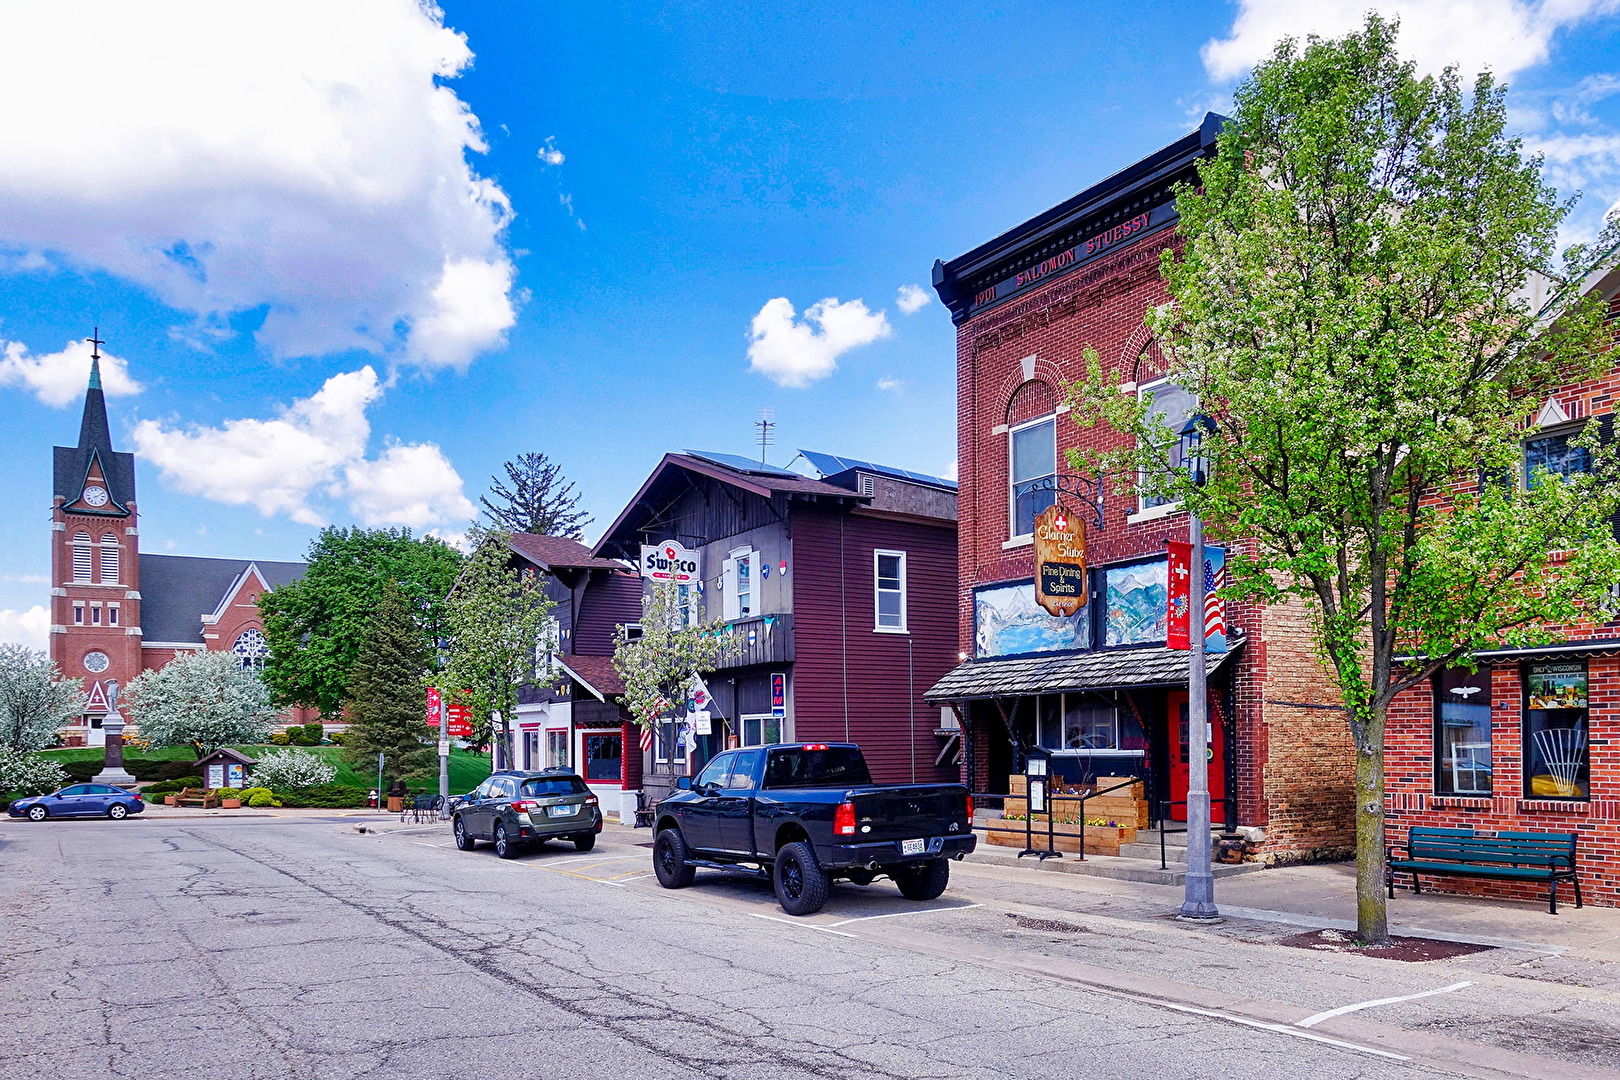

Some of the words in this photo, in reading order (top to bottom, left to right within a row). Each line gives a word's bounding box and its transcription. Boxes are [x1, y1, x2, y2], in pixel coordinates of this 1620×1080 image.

[974, 286, 997, 307] 1901
[1016, 248, 1076, 287] SALOMON
[1087, 212, 1151, 253] STUESSY
[1038, 525, 1074, 542] Glarner
[1057, 543, 1084, 558] Stube
[1042, 566, 1059, 576] Fine
[1059, 566, 1081, 580] Dining
[1060, 576, 1065, 584] &
[1050, 581, 1075, 594] Spirits
[774, 676, 783, 705] ATM
